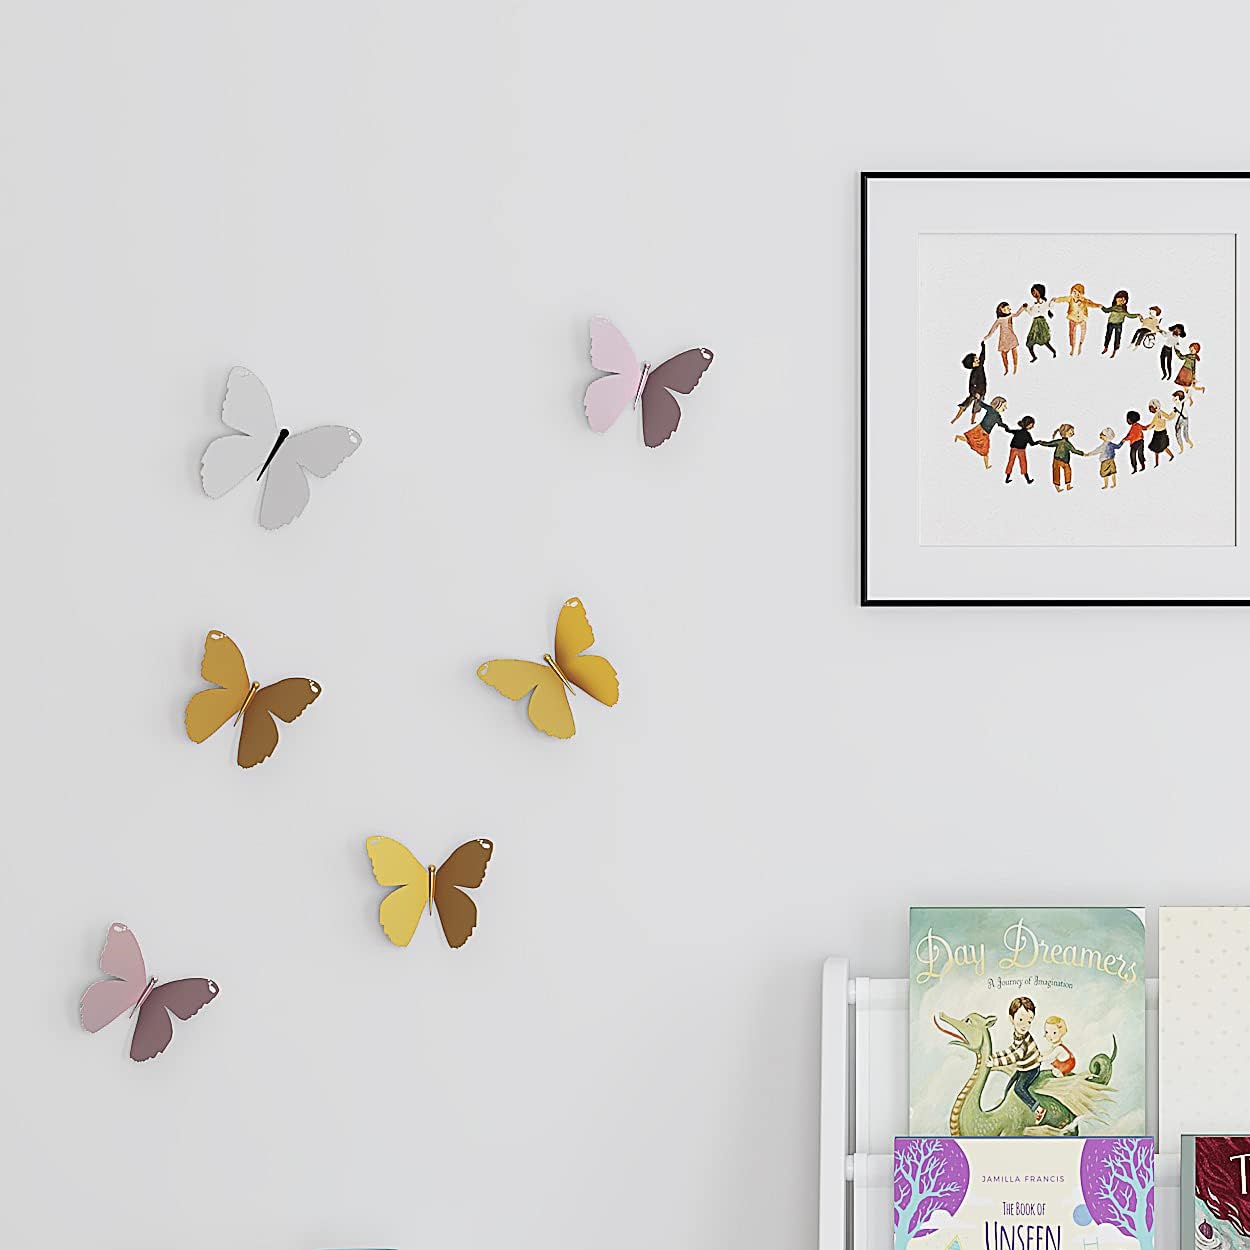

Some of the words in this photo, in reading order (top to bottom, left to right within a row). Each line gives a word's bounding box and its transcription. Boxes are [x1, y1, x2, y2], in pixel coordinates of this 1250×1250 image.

[916, 928, 984, 984] Day
[999, 918, 1137, 985] Dreamers
[988, 978, 995, 989] A
[997, 976, 1023, 989] Journey
[1024, 976, 1033, 985] of
[1034, 976, 1073, 989] Imagination
[981, 1175, 1021, 1183] JAMILLA
[1025, 1175, 1065, 1183] FRANCIS
[1015, 1202, 1035, 1216] BOOK
